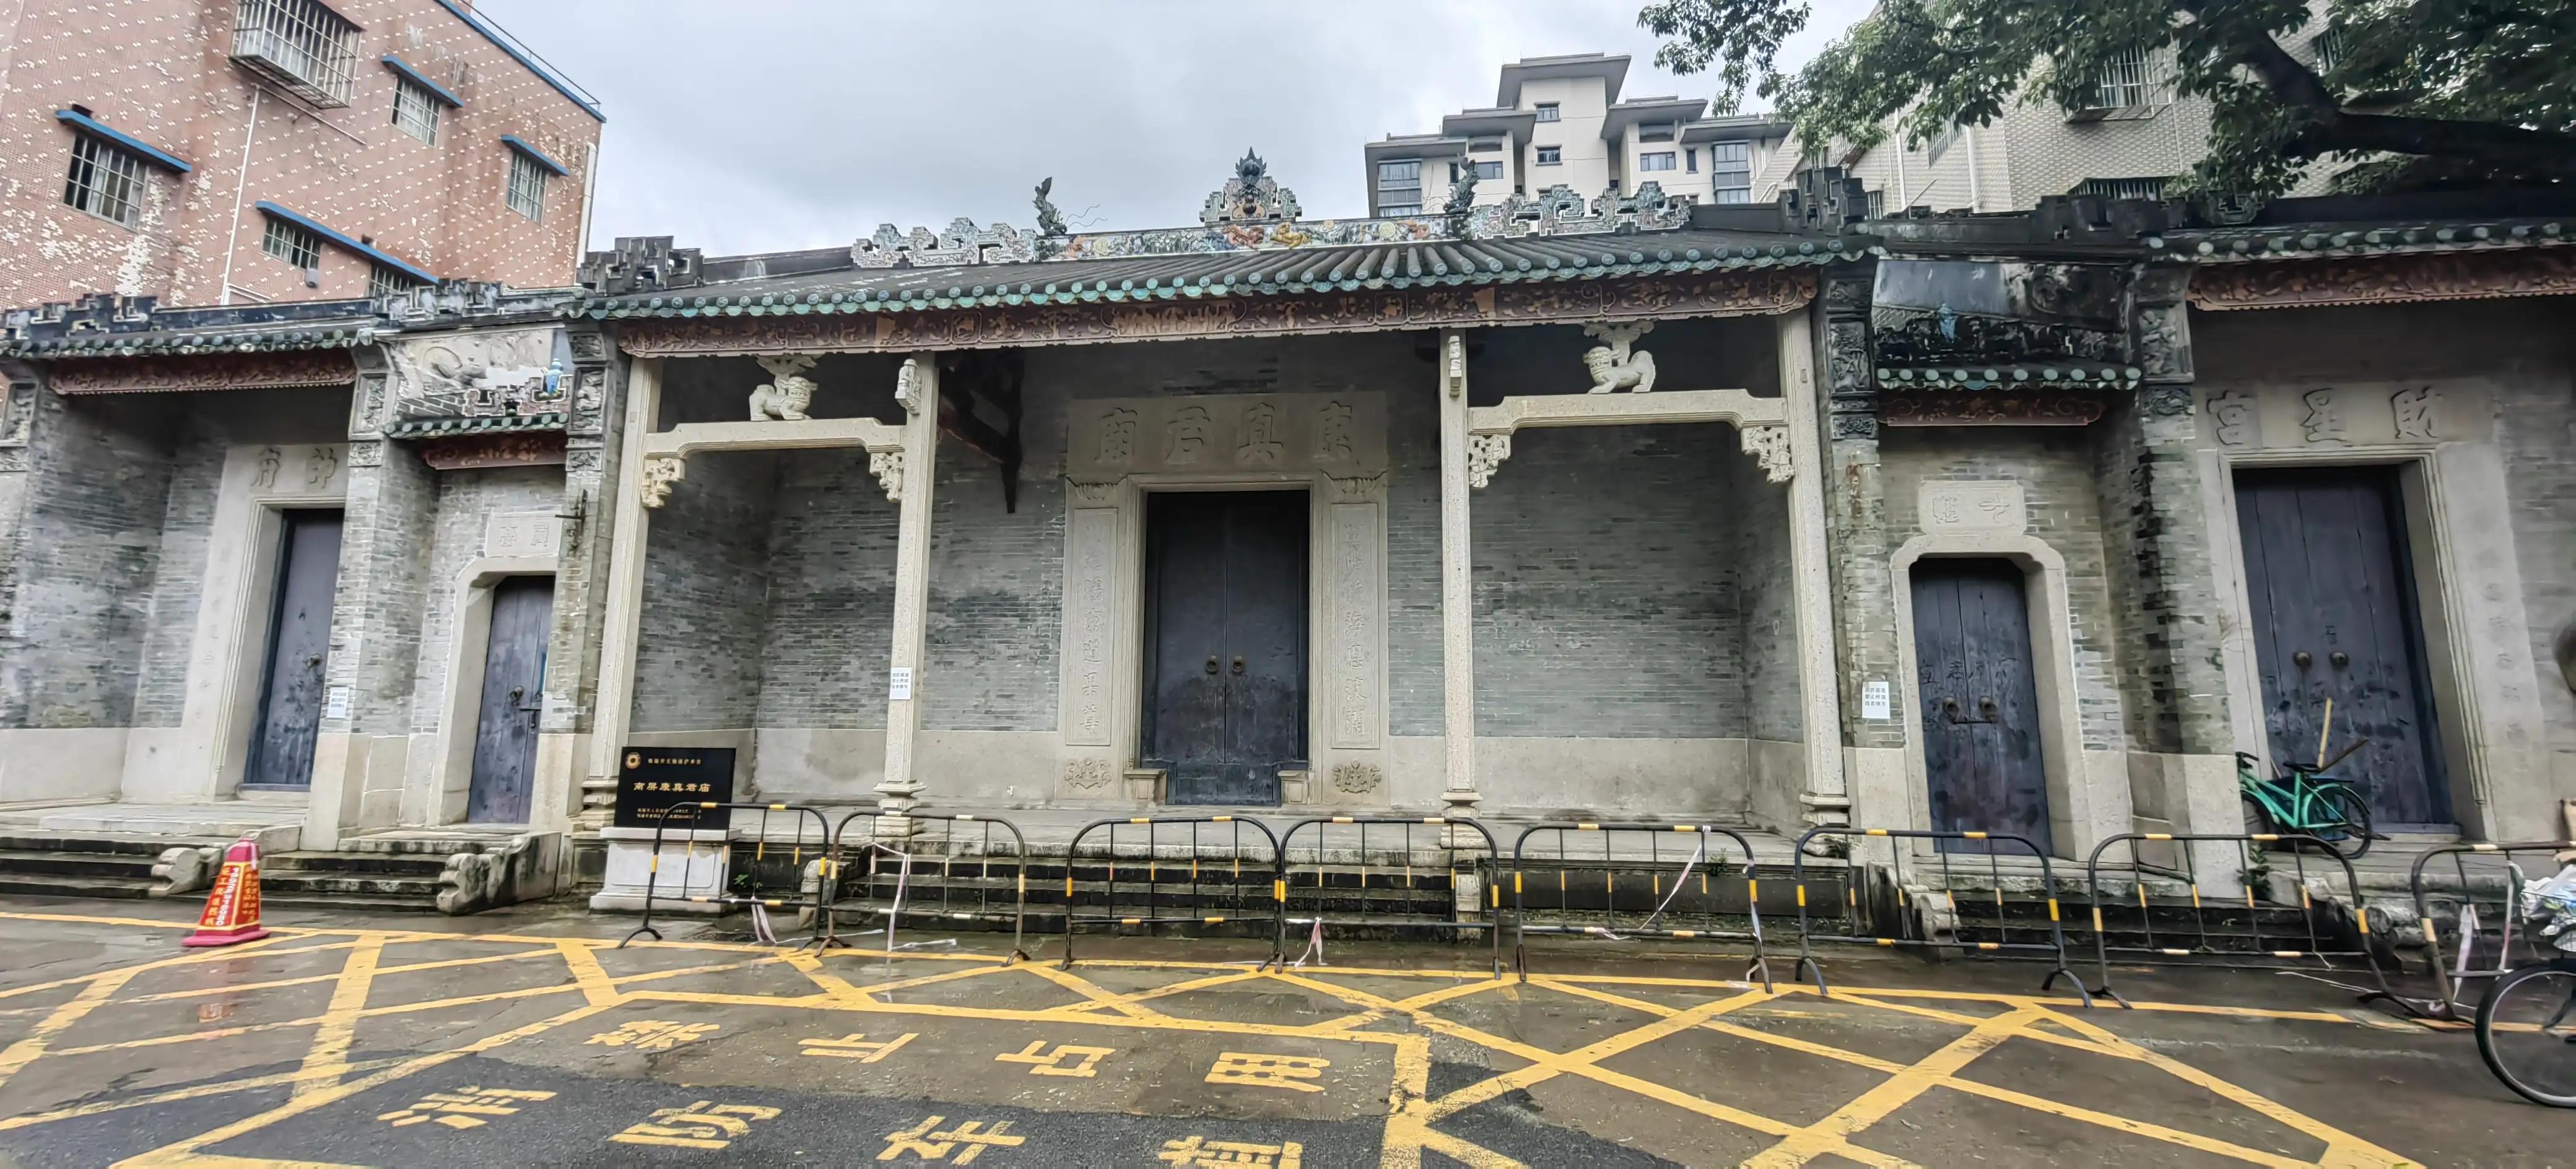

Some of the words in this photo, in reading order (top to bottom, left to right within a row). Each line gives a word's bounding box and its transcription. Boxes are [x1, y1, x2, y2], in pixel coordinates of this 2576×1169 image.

[633, 782, 711, 793] 南屏康真君庙
[583, 1019, 1331, 1093] 禁止占用
